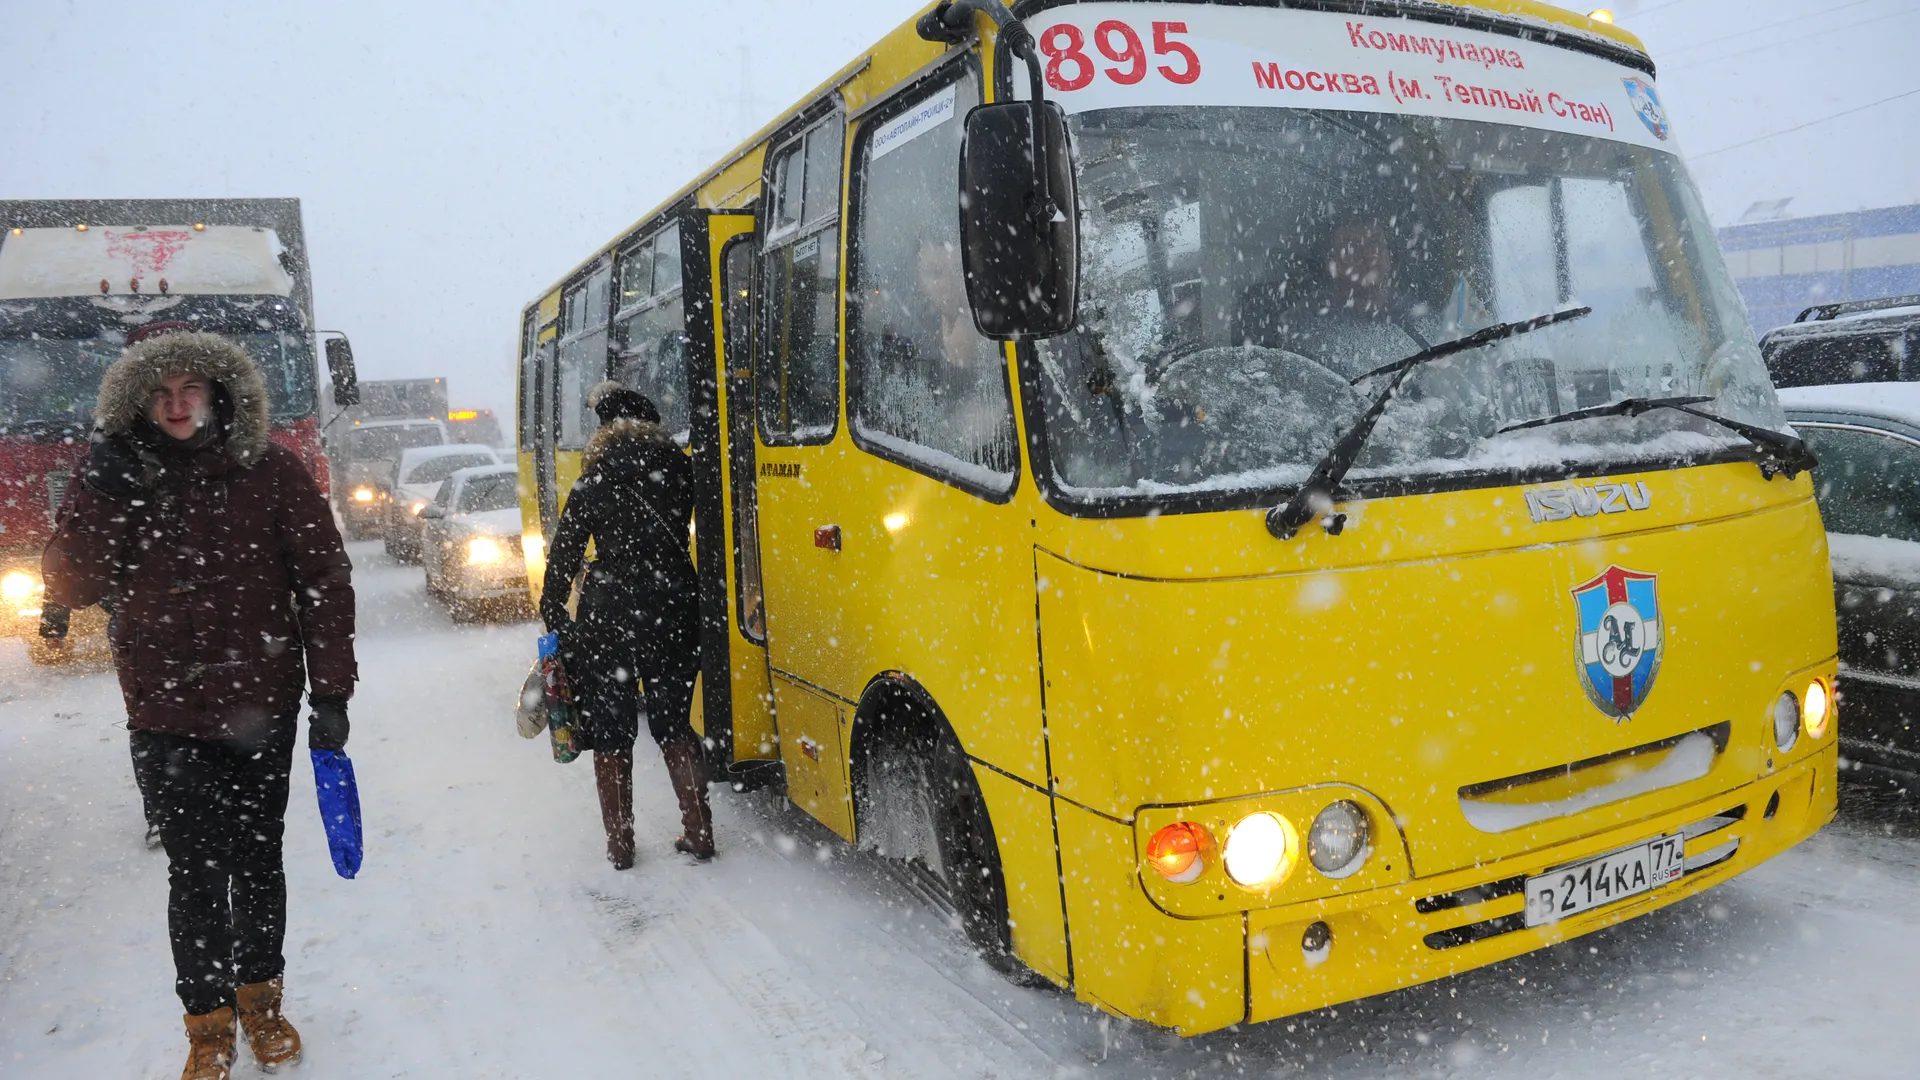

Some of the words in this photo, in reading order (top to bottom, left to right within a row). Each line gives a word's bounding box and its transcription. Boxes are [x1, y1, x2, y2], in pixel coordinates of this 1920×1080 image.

[1039, 20, 1201, 92] 895
[1346, 21, 1525, 69] Коммунарка
[1252, 61, 1381, 96] Москва
[1388, 70, 1431, 105] (м.
[1433, 74, 1544, 114] Теплый
[1547, 91, 1614, 132] Стан)
[760, 463, 800, 477] ATAMAN
[1524, 481, 1651, 524] ISUZU
[1652, 839, 1676, 870] 77
[1652, 871, 1670, 882] RUS
